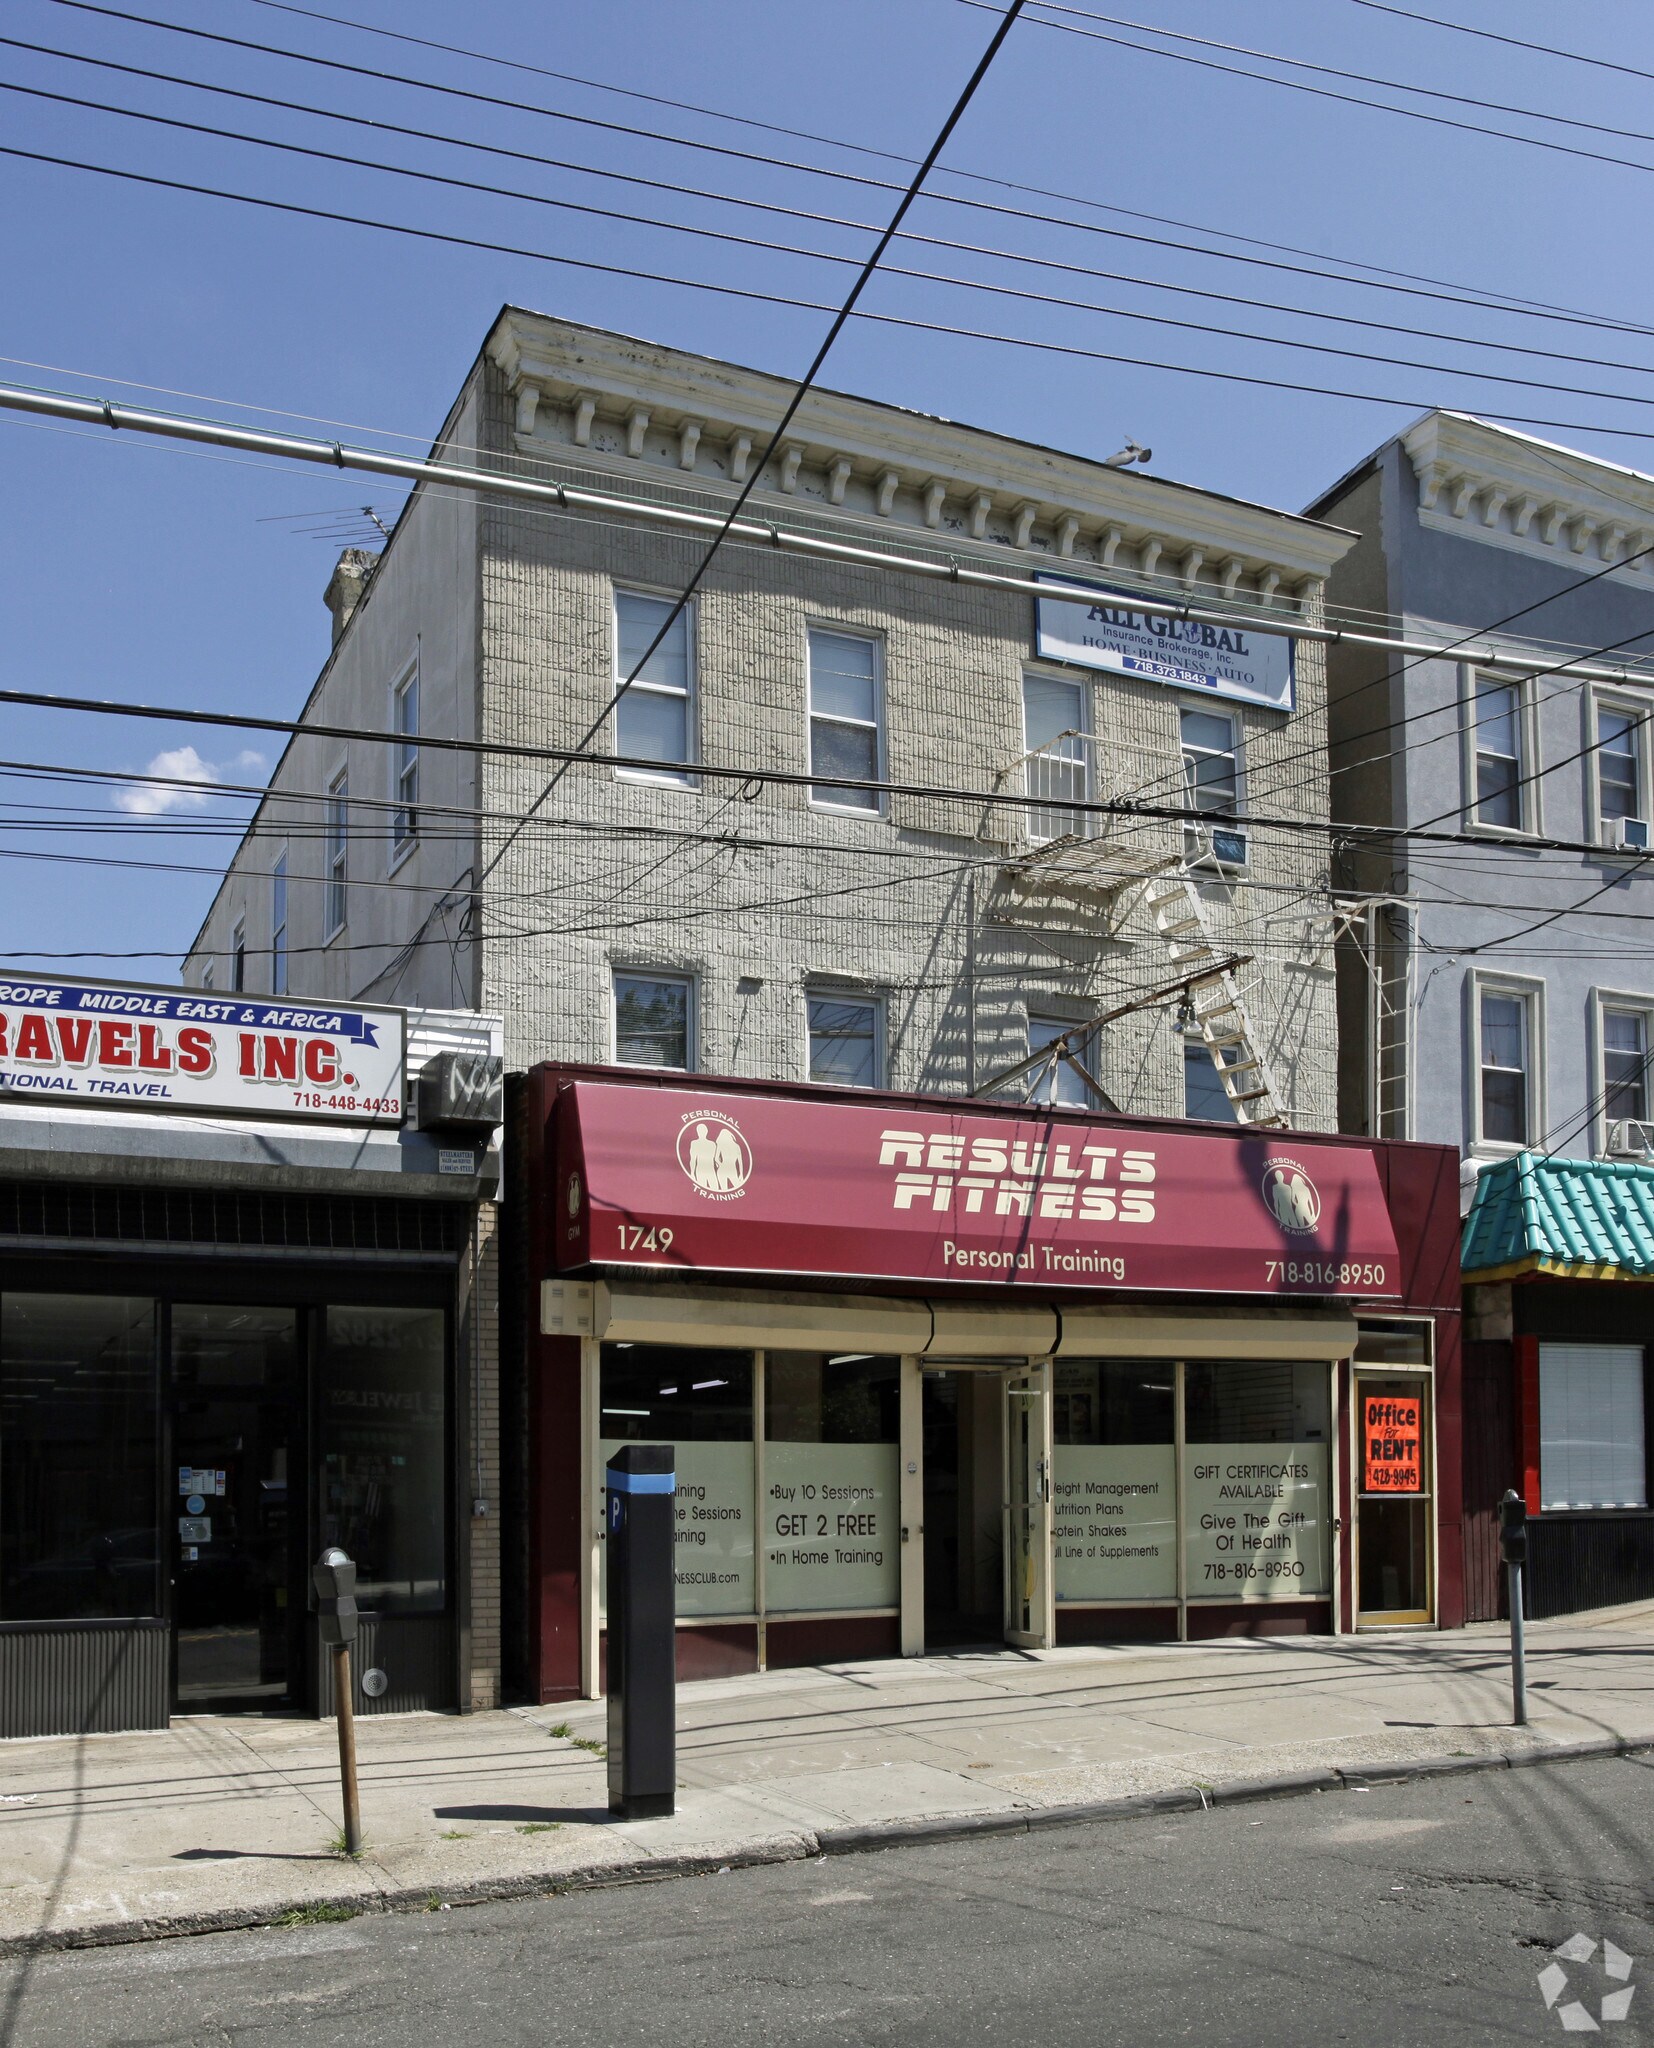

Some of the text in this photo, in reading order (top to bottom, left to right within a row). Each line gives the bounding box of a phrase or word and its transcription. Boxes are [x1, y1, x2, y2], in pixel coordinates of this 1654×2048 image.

[1087, 606, 1140, 630] ALL
[1103, 625, 1234, 665] Insurance Brokerage, Inc.
[1082, 635, 1255, 684] HOME BUSINESS AUTO
[1133, 659, 1207, 685] 718.373.1843
[79, 993, 168, 1015] MIDDLE
[176, 1002, 237, 1022] EAST
[241, 1008, 255, 1023] &
[262, 1011, 342, 1031] AFRICA
[238, 1033, 360, 1086] INC.
[87, 1079, 173, 1098] TRAVEL
[293, 1092, 400, 1115] 718-448-4433
[681, 1109, 741, 1129] PERSONAL
[878, 1130, 1156, 1184] RESULTS
[1262, 1157, 1307, 1174] PERSONAL
[693, 1183, 746, 1201] TRAINING
[893, 1172, 1156, 1223] FITNESS
[568, 1224, 580, 1240] GYM
[617, 1225, 674, 1253] 1749
[1280, 1223, 1319, 1237] TRAINING
[943, 1240, 1126, 1281] Personal Training
[1265, 1261, 1385, 1285] 718-816-8950
[1368, 1403, 1417, 1427] Office
[1371, 1439, 1417, 1461] RENT
[1194, 1464, 1309, 1479] GIFT CERTIFICATES
[675, 1483, 706, 1500] ining
[802, 1484, 816, 1499] 10
[821, 1484, 874, 1500] Sessions
[1053, 1482, 1160, 1497] eight Management
[1219, 1484, 1284, 1499] AVAILABLE
[692, 1506, 741, 1520] Sessions
[1096, 1503, 1124, 1515] Plans
[776, 1514, 877, 1537] GET 2 FREE
[1088, 1524, 1127, 1537] Shakes
[1200, 1512, 1305, 1530] Give The Gift
[1216, 1533, 1292, 1551] Of Health
[776, 1549, 883, 1566] In Home Training
[1065, 1545, 1083, 1558] Line
[1087, 1545, 1096, 1558] of
[1100, 1545, 1159, 1560] Supplements
[1203, 1560, 1304, 1580] 718-816-8950
